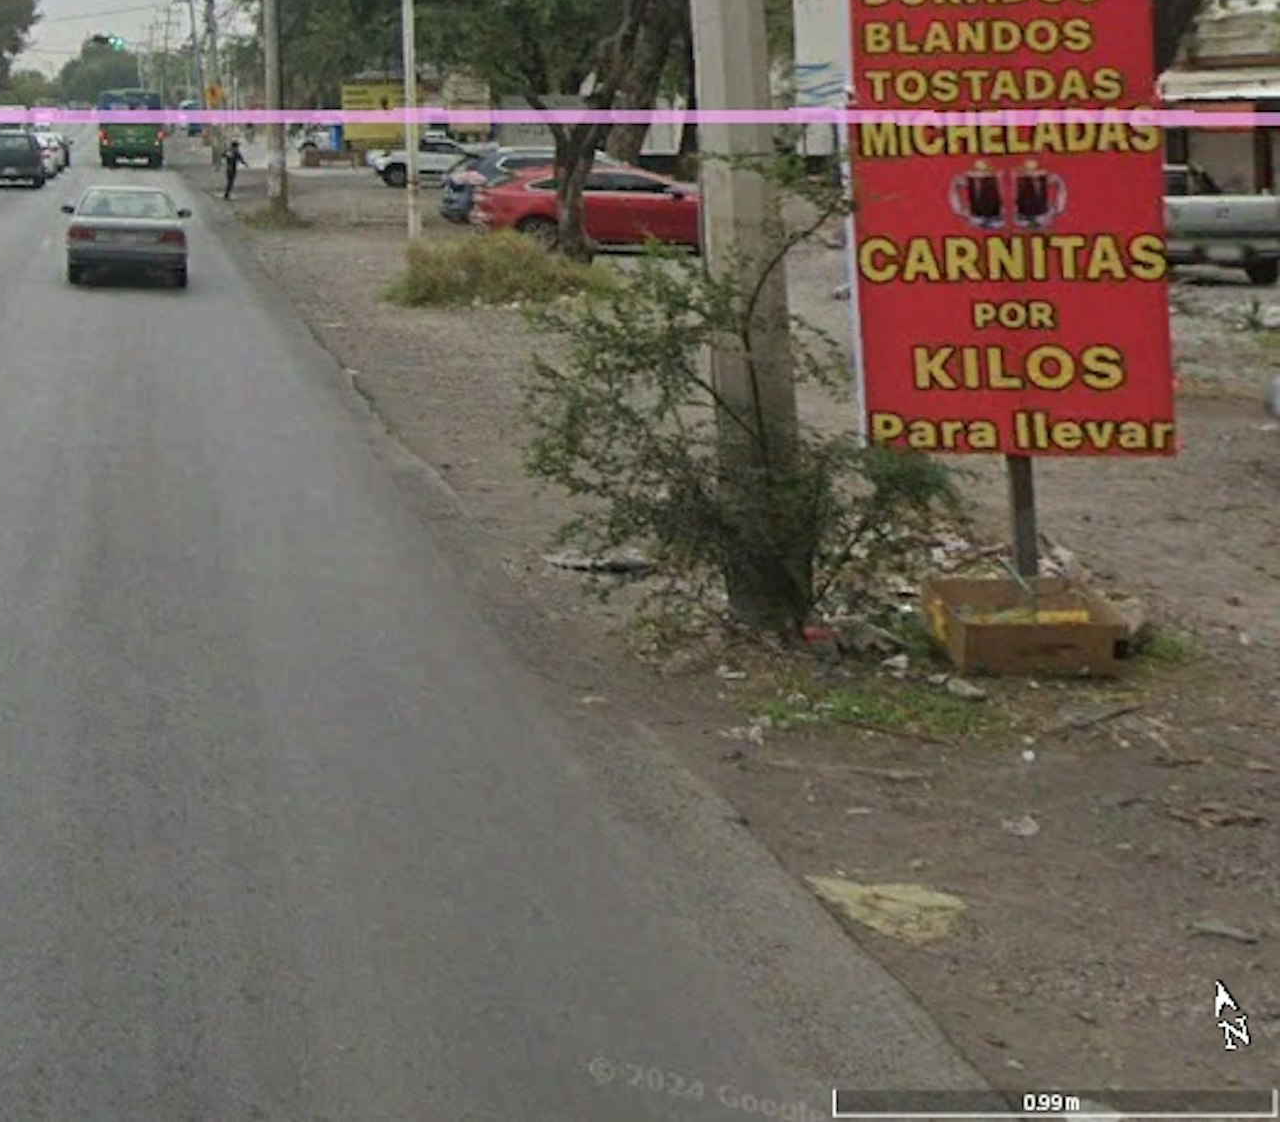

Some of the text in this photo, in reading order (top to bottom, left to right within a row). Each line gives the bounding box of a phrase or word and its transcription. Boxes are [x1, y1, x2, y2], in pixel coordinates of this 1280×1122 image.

[864, 18, 1093, 55] BLANDOS
[865, 68, 1124, 103] TOSTADAS
[859, 105, 1161, 158] MICHELADAS
[858, 234, 1167, 284] CARNITAS
[973, 301, 1056, 330] POR
[912, 344, 1125, 391] KILOS
[870, 410, 1174, 450] Para llevar
